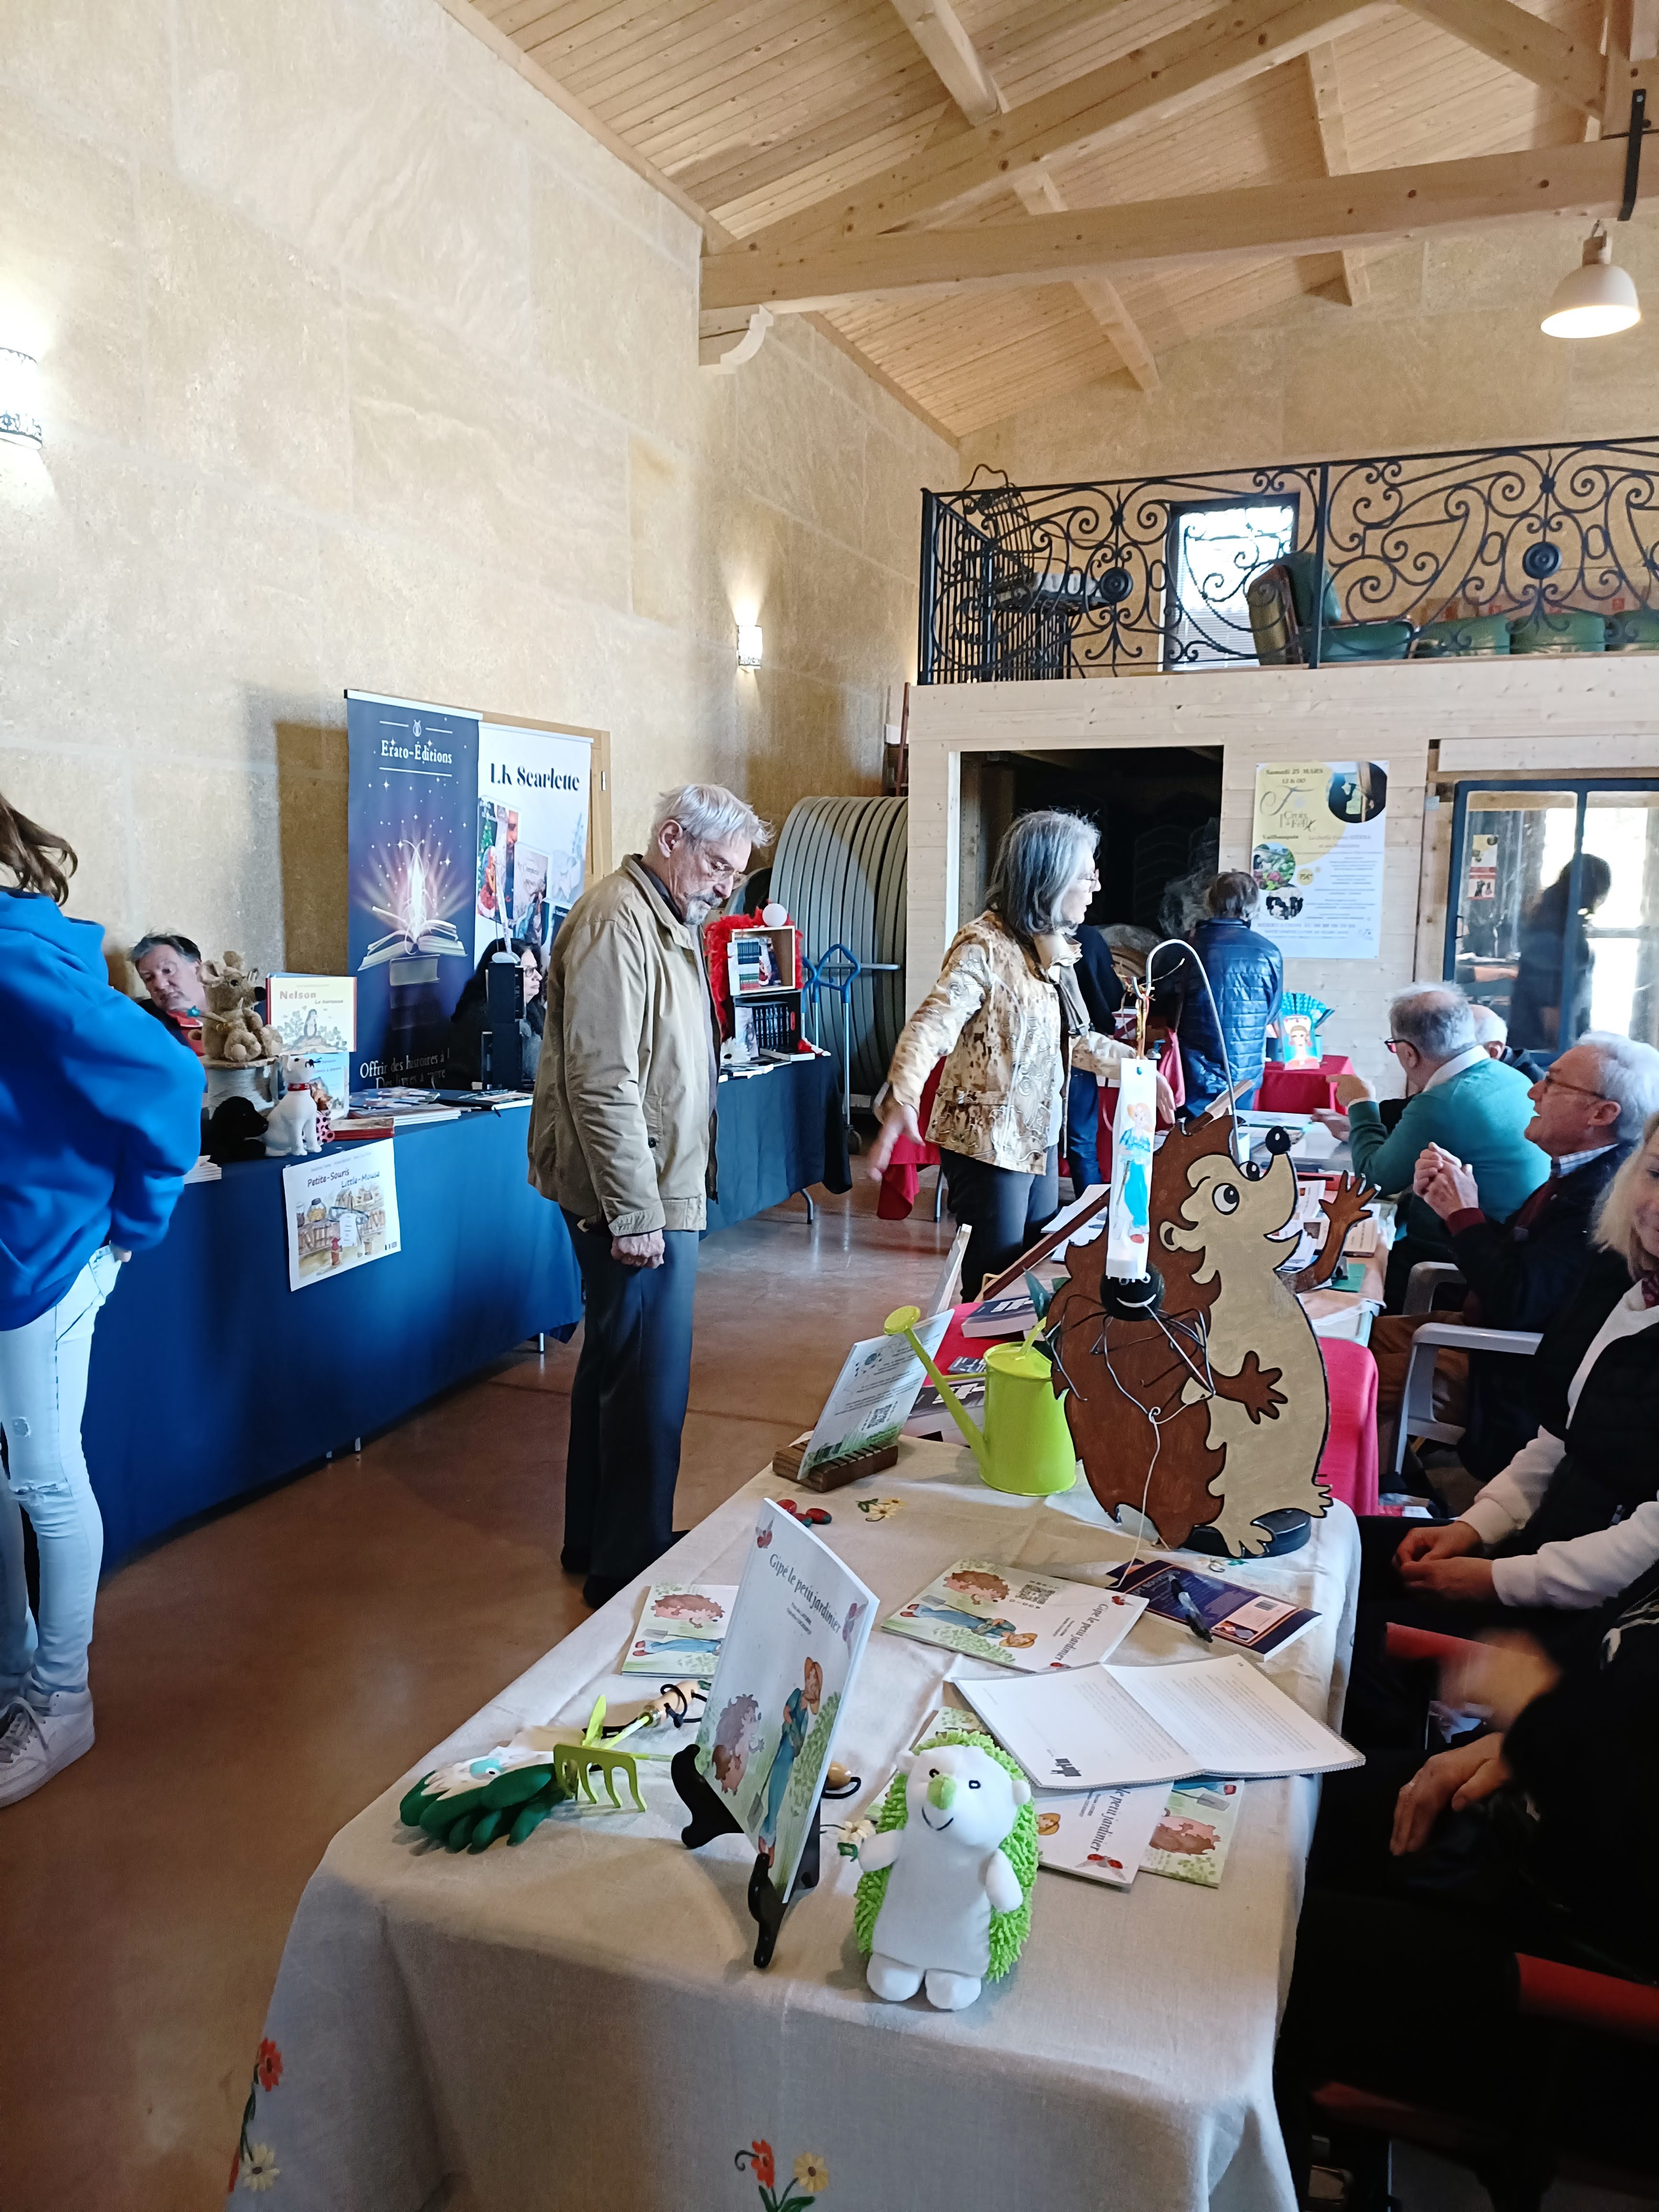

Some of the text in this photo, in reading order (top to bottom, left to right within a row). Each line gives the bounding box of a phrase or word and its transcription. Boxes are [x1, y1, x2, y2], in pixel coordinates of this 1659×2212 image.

[381, 740, 452, 764] Erato-Éditions
[517, 765, 580, 791] Scarlette
[280, 991, 316, 999] Nelson
[360, 1060, 387, 1078] Offrir
[391, 1058, 403, 1072] des
[307, 1167, 350, 1187] Petite-Souris
[770, 1554, 789, 1578] Gipé
[788, 1567, 796, 1585] le
[794, 1579, 813, 1602] petit
[809, 1591, 841, 1633] jardinier
[1055, 1634, 1083, 1660] jardinier
[1106, 1795, 1122, 1816] petit
[1090, 1813, 1118, 1851] jardinier
